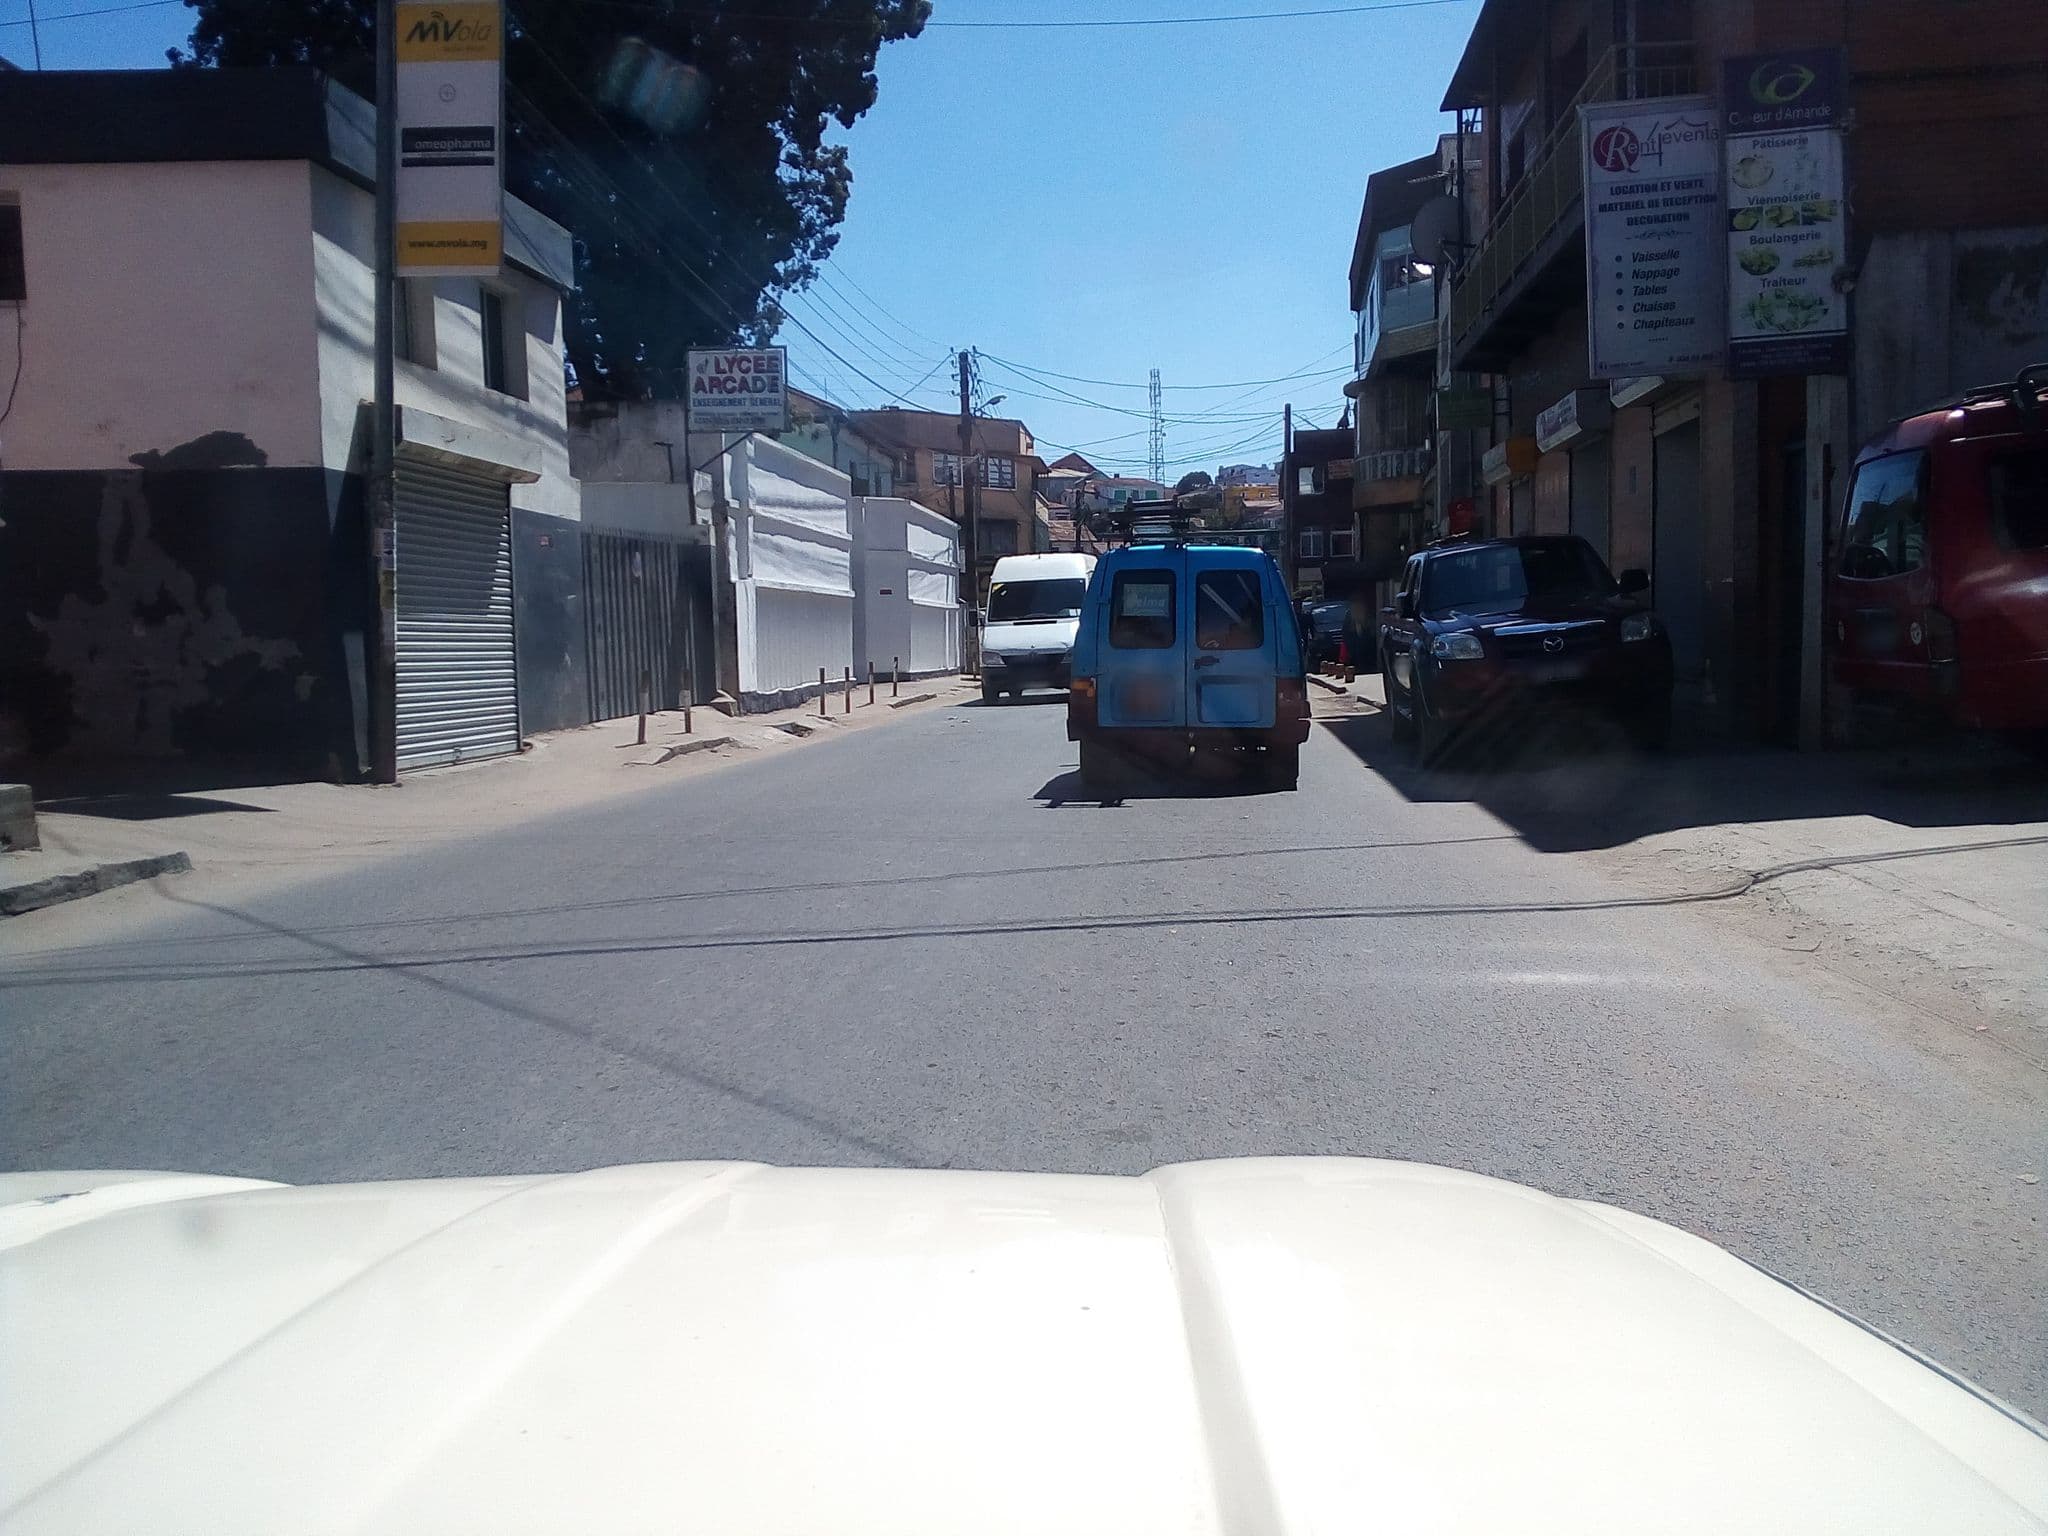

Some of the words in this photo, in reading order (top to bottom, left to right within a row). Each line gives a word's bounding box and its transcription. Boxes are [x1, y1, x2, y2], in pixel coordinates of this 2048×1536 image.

[405, 18, 491, 43] MVola
[1610, 183, 1658, 195] LOCATION
[1660, 180, 1671, 192] ET
[1674, 178, 1704, 190] VENTE
[1598, 201, 1645, 213] MATERIEL
[1648, 199, 1659, 209] DE
[1663, 194, 1717, 207] RECEPTION
[1747, 191, 1822, 206] Viennoiserie
[1626, 212, 1690, 226] DECORATION
[408, 238, 488, 251] www.mvola.mg
[1750, 230, 1822, 246] Boulangerie
[1631, 249, 1680, 263] Vaisselle
[1631, 267, 1680, 281] Nappage
[1760, 276, 1808, 288] Traiteur
[1632, 285, 1668, 297] Tables
[1632, 301, 1676, 313] Chaises
[1633, 317, 1696, 330] Chapiteaux
[714, 355, 780, 374] LYCEE
[694, 375, 780, 394] ARCADE
[692, 398, 746, 407] ENSEIGNEMENT
